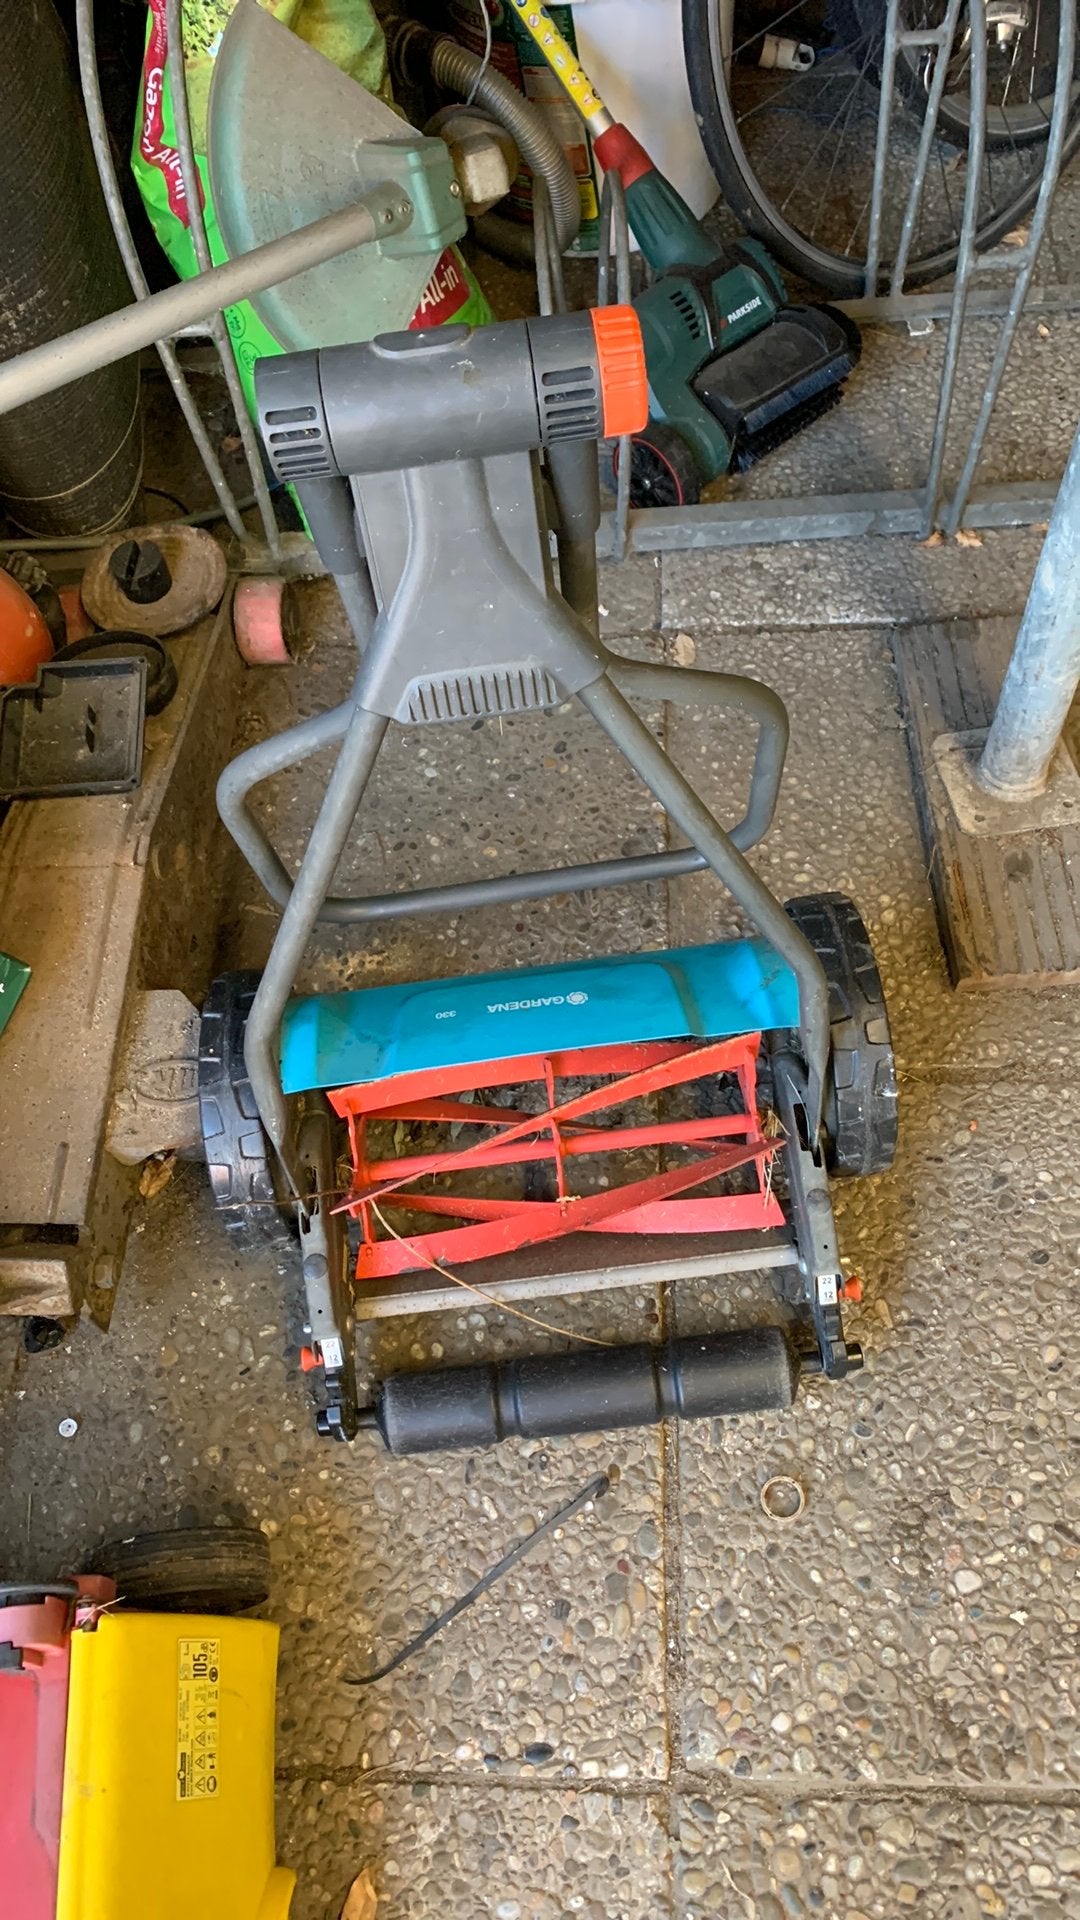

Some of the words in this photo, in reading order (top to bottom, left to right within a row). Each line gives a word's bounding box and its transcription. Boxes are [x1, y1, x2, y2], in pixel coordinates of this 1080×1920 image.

[143, 67, 164, 153] Gazon
[420, 264, 460, 314] All-in
[727, 296, 762, 324] PARKSIDE
[487, 996, 565, 1013] GARDENA
[435, 1010, 457, 1020] 330
[822, 1277, 833, 1285] 22
[824, 1290, 834, 1299] 12
[325, 1341, 336, 1349] 22
[192, 1653, 208, 1679] 105
